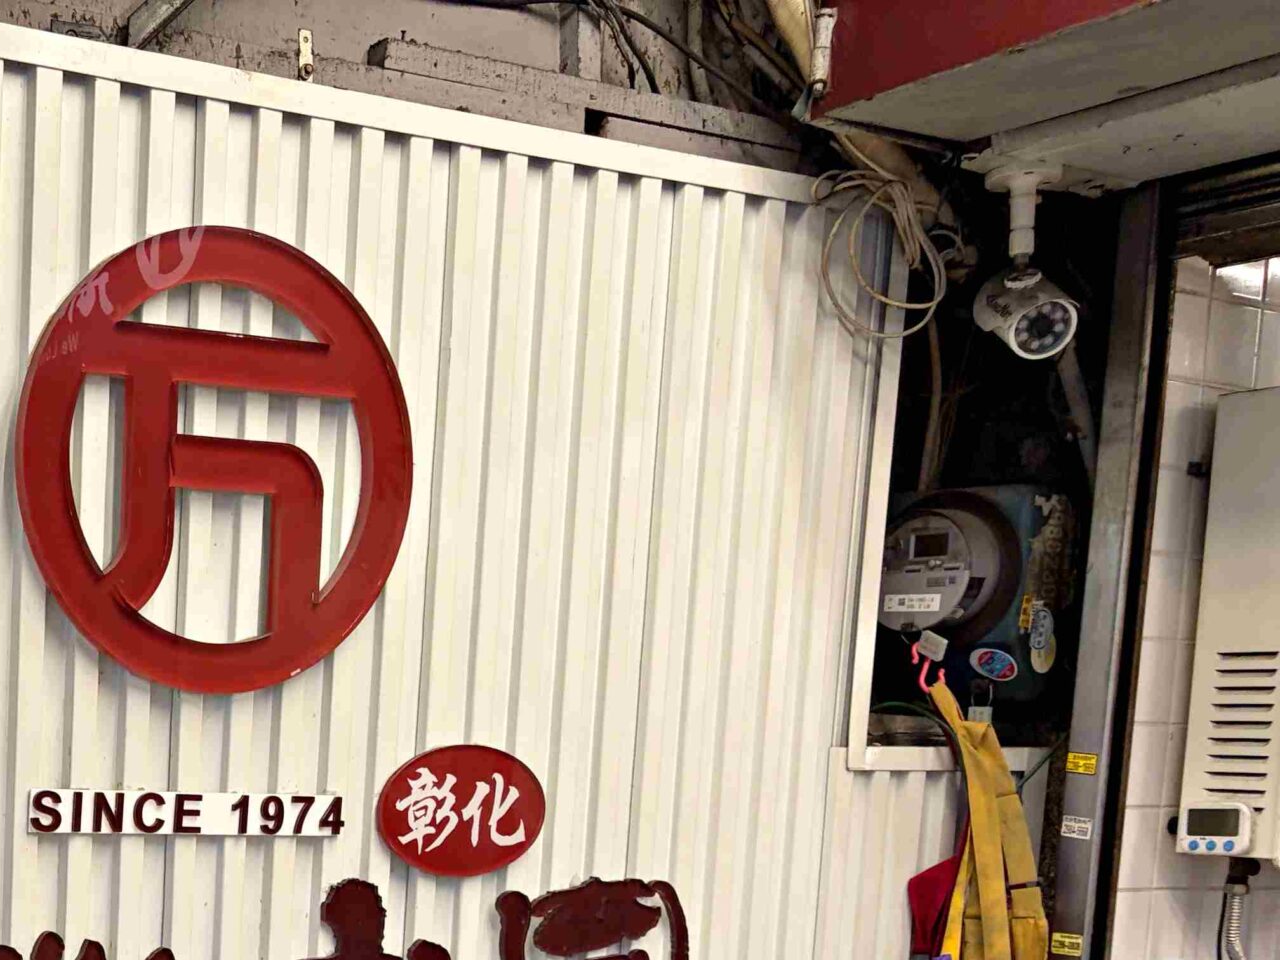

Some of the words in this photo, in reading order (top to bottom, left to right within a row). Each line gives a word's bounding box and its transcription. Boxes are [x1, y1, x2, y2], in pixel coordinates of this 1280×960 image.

[28, 789, 204, 836] SINCE
[230, 792, 346, 836] 1974
[395, 767, 528, 856] 彰化
